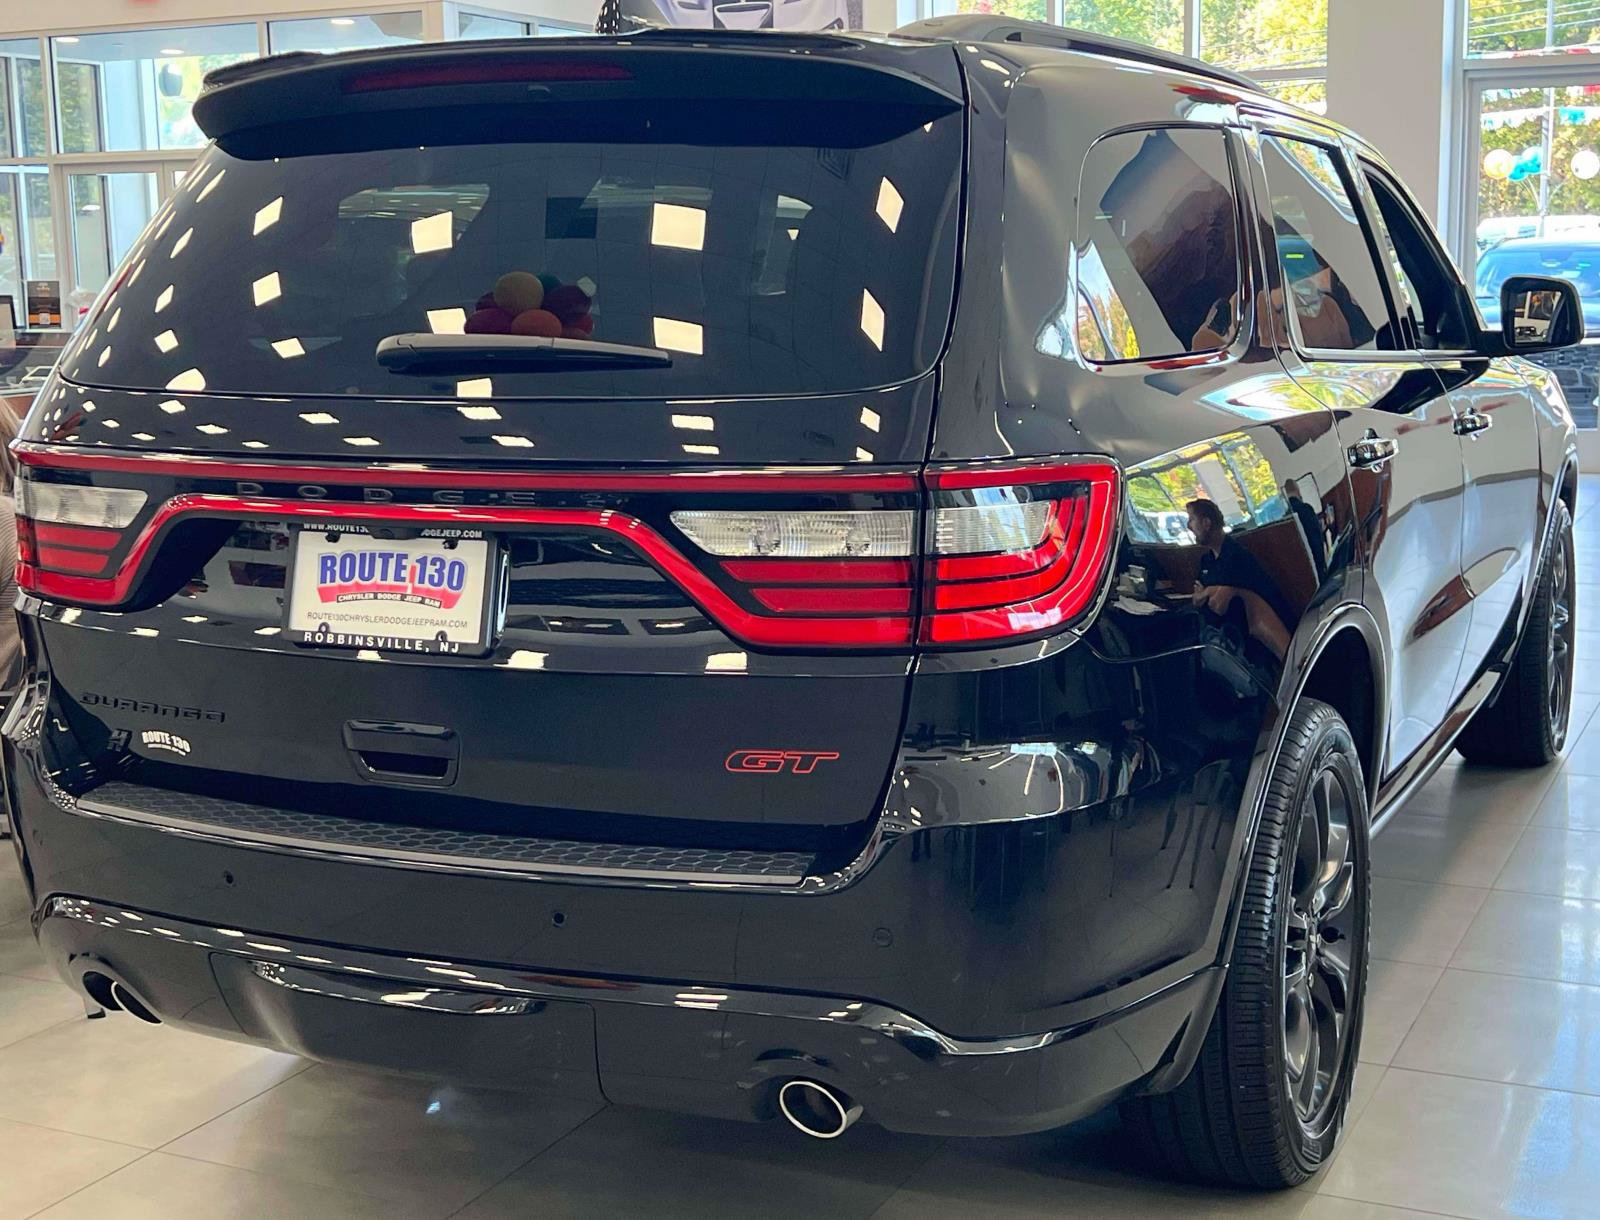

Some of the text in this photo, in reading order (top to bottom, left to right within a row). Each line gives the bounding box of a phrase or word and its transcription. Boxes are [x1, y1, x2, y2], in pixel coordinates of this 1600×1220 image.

[236, 482, 536, 505] DODGE
[319, 551, 467, 592] ROUTE 130
[338, 592, 441, 608] CHRYSLER DODGE JEEP RAM
[307, 611, 468, 629] ROUTE130CHRYSLERDODGEJEEPRAM.COM
[304, 631, 460, 653] ROBBINSVILLE, NJ
[141, 730, 171, 745] ROUTE
[171, 735, 191, 753] 130
[725, 750, 840, 773] GT
